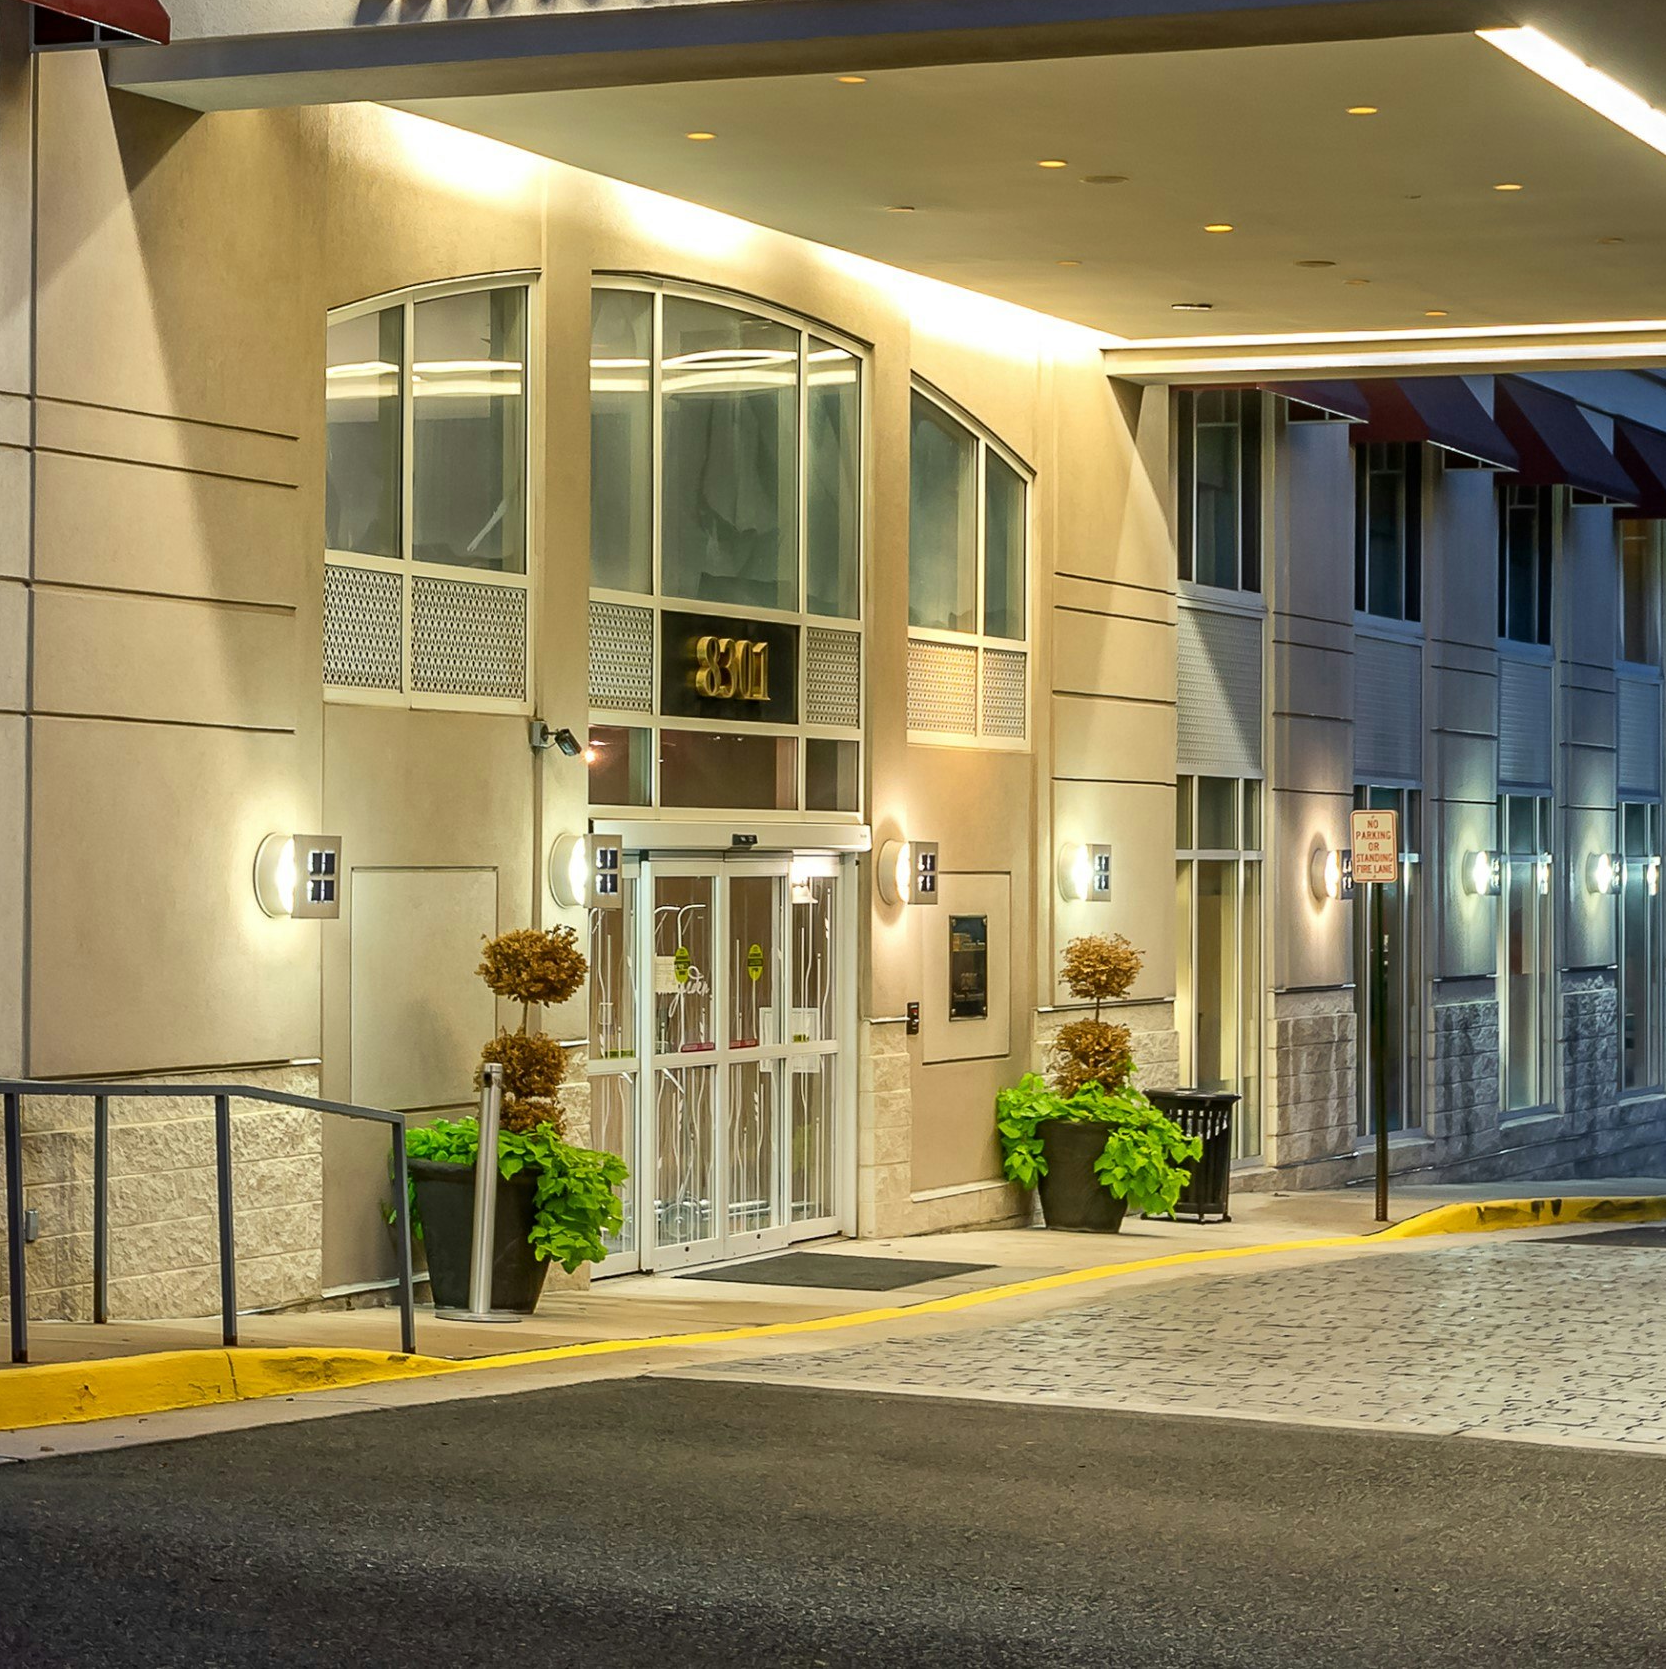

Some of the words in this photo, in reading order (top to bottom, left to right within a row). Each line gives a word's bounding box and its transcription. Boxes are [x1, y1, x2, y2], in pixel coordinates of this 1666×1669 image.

[695, 636, 771, 701] 8301
[1367, 819, 1379, 829] NO
[1355, 830, 1392, 840] PARKING
[1368, 842, 1380, 851] OR
[1356, 853, 1393, 862] STANDING
[1356, 864, 1373, 874] FIRE
[1374, 864, 1393, 874] LANE
